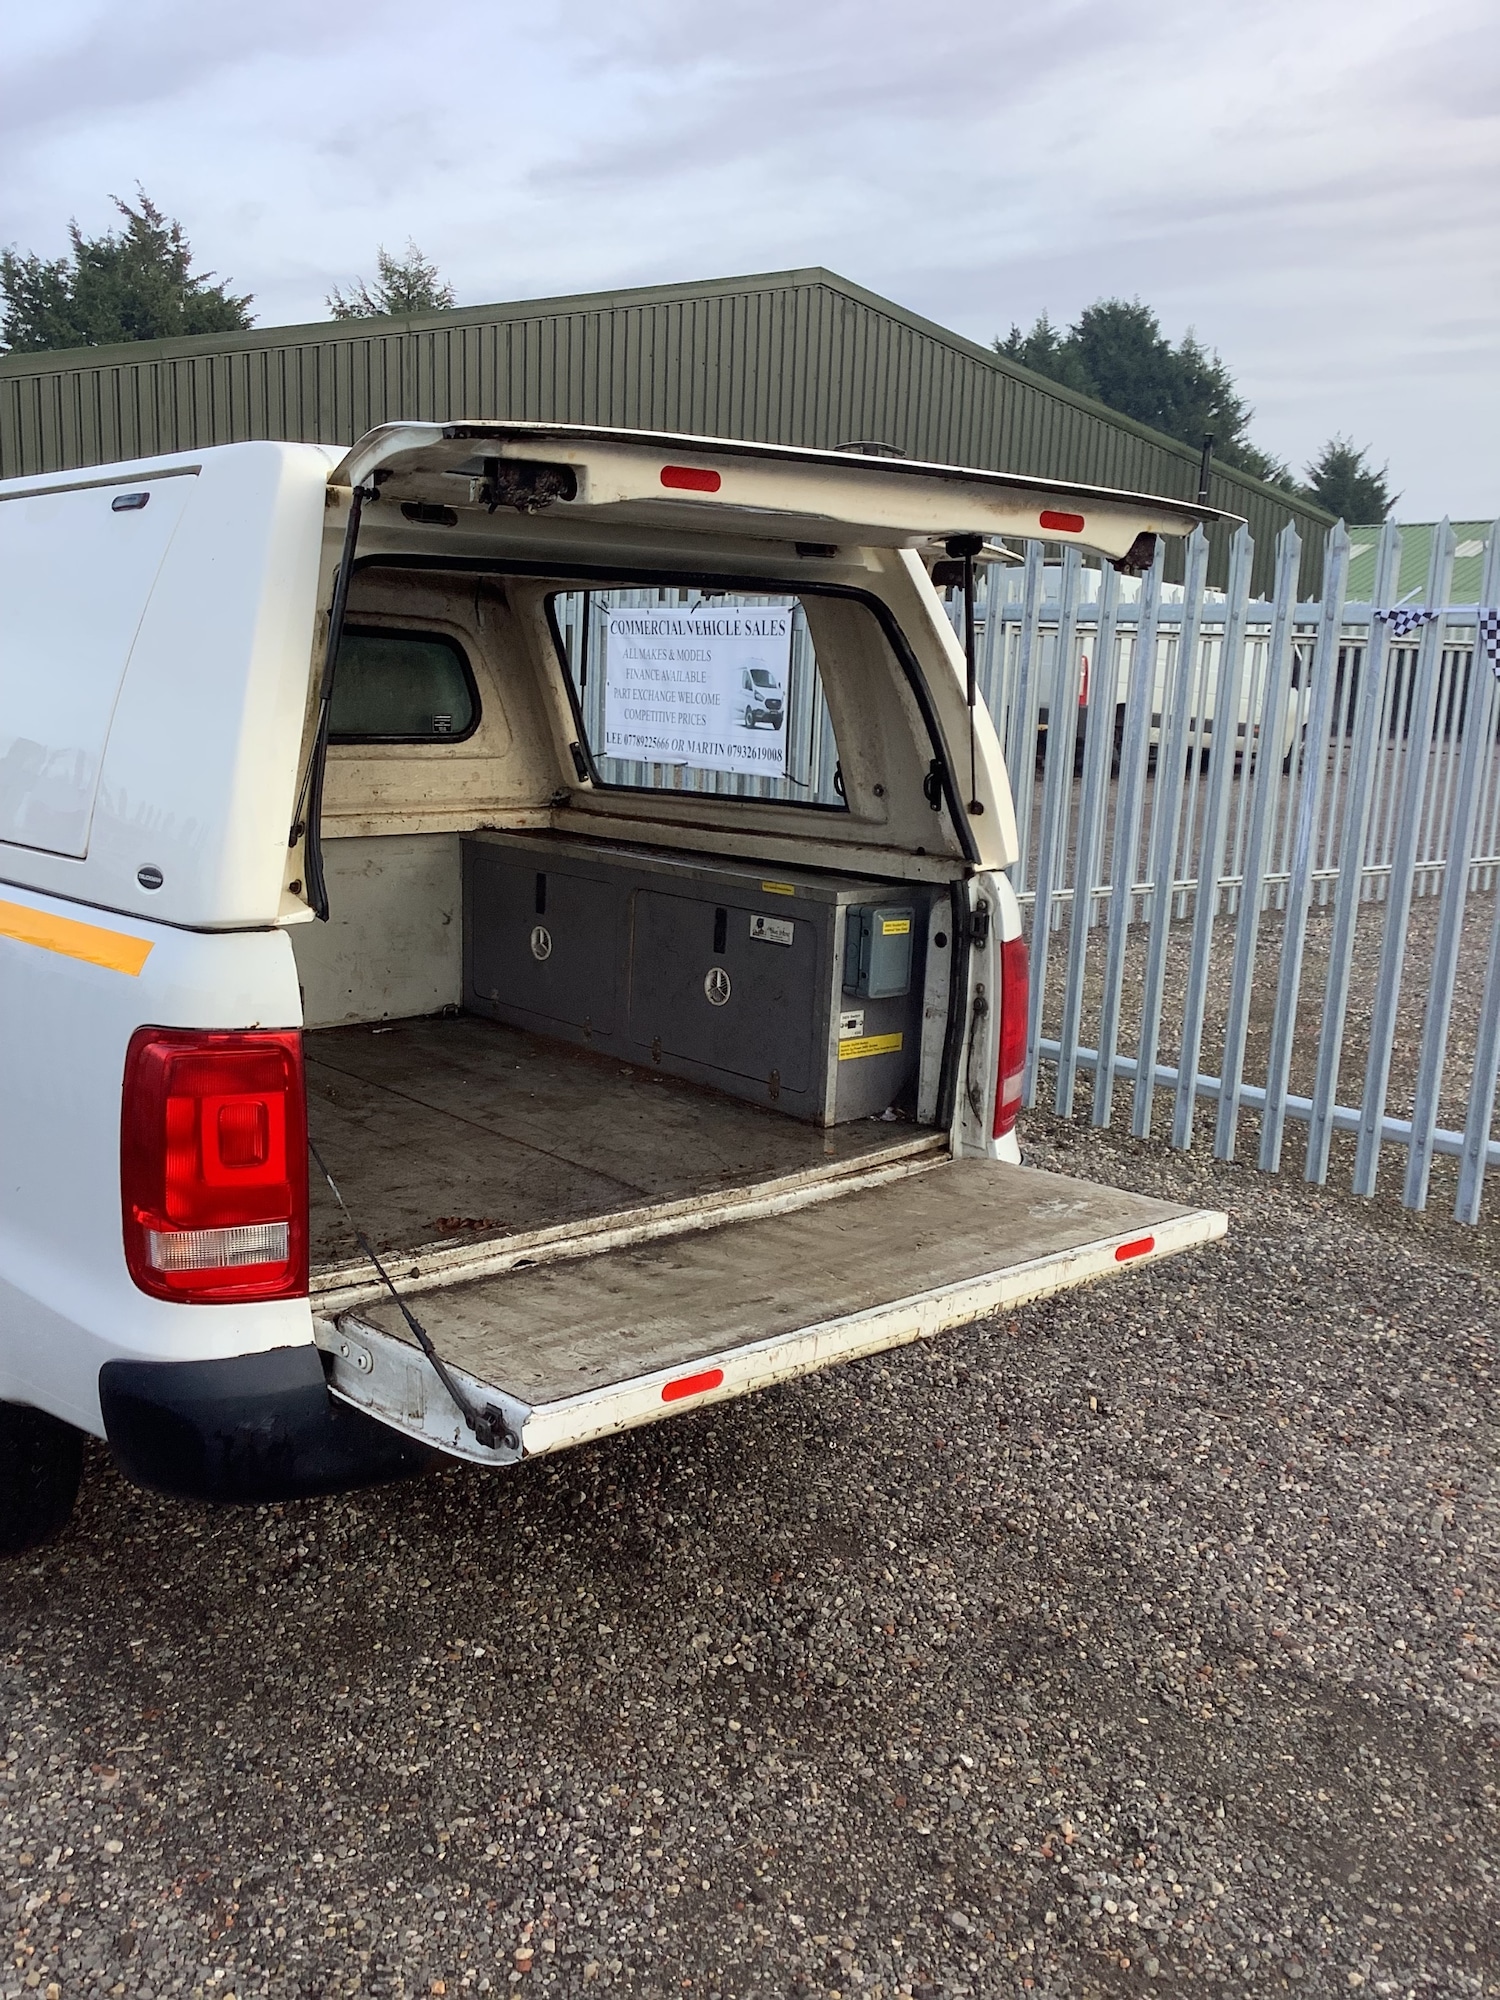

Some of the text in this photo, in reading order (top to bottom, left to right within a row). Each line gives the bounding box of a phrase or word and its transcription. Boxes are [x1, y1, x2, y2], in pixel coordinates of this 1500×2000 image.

[610, 619, 785, 636] COMMERCIAL VEHICLE SALES
[622, 648, 712, 662] ALL MAKES & MODELS
[626, 668, 707, 683] FINANCE AVAILABLE
[613, 687, 721, 706] PART EXCHANGE WELCOME
[624, 708, 707, 726] COMPETITIVE PRICES
[606, 732, 783, 762] LEE 07789225666 OR MARTIN 07932619008
